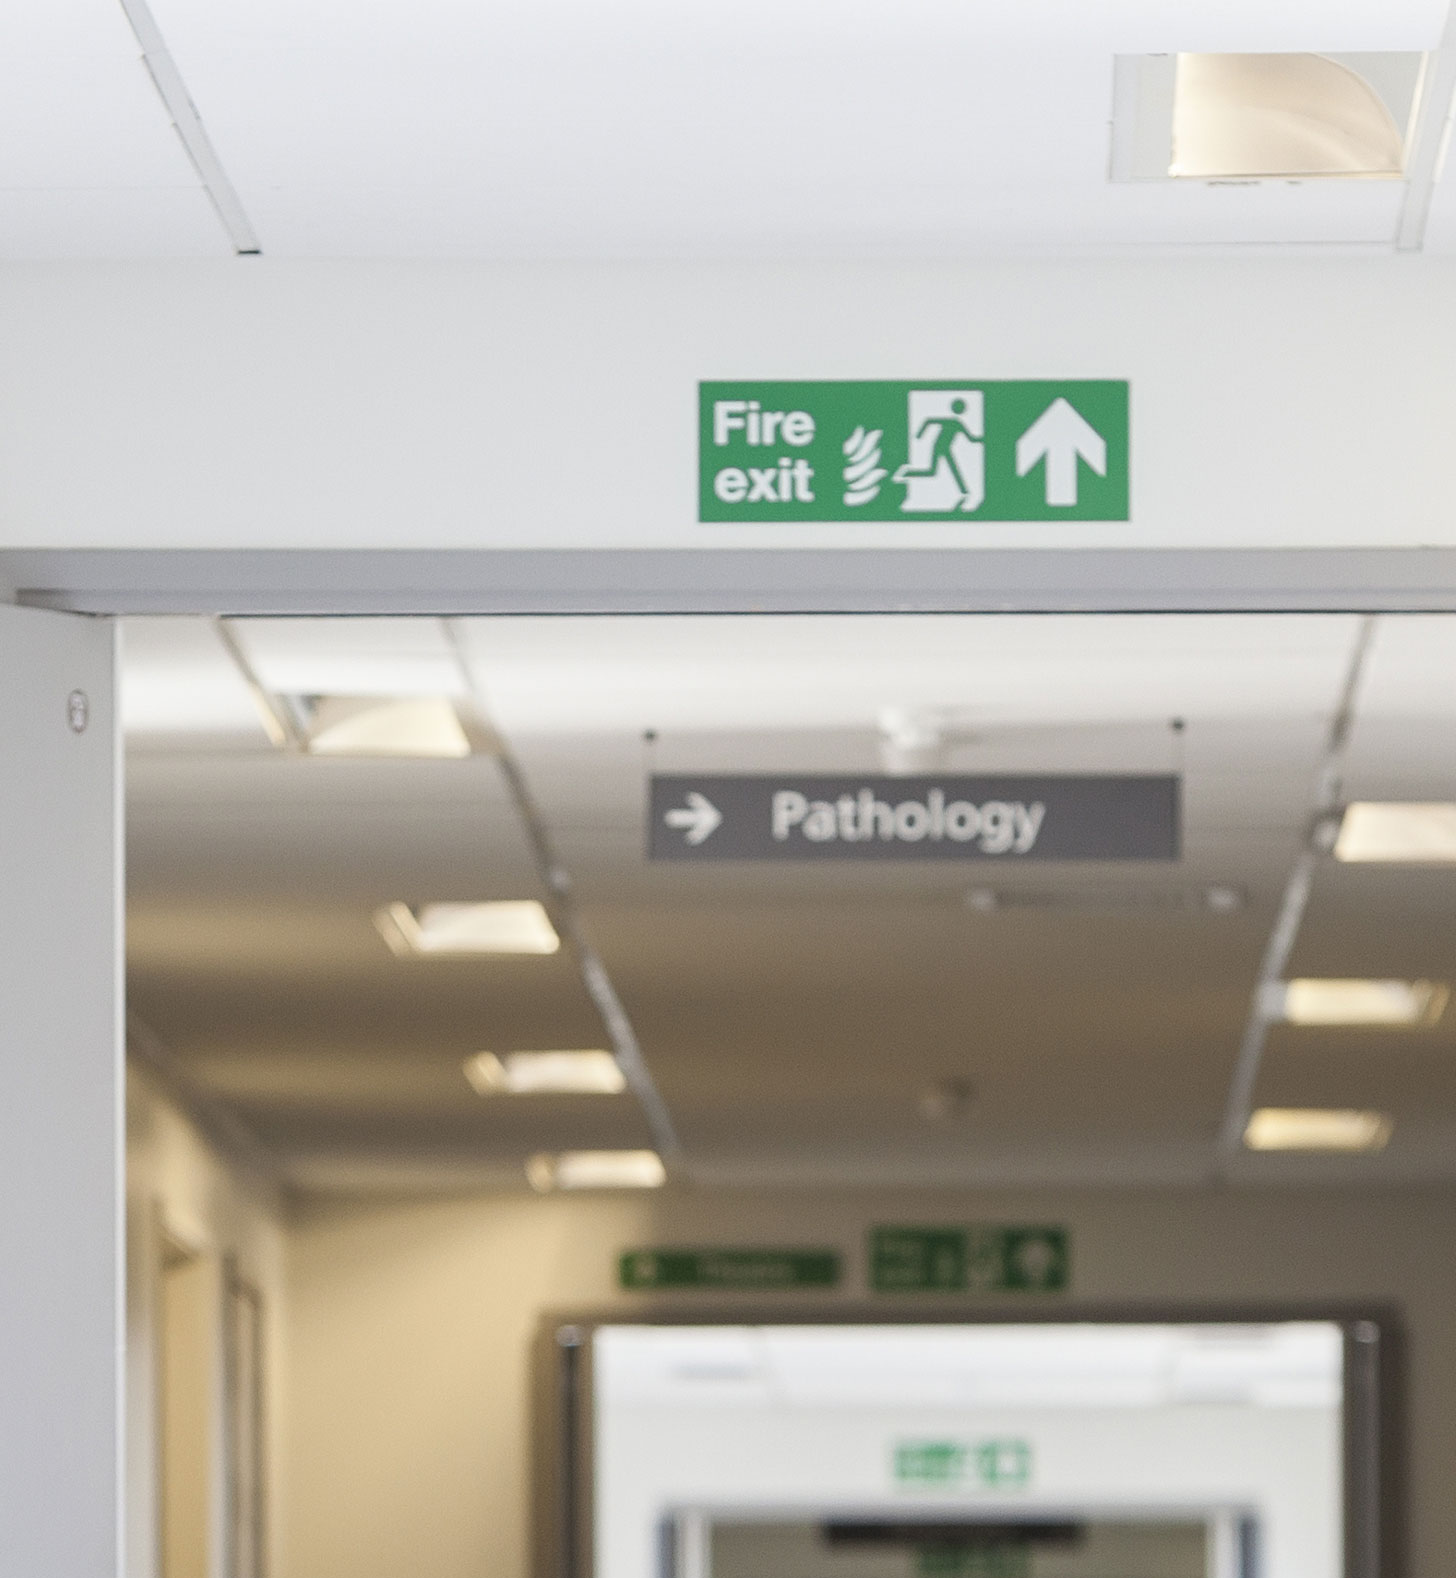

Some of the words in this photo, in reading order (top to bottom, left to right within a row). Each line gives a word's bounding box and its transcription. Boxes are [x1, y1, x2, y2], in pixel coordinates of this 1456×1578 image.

[713, 400, 815, 445] Fire
[714, 456, 814, 502] exit
[771, 788, 1045, 853] Pathology
